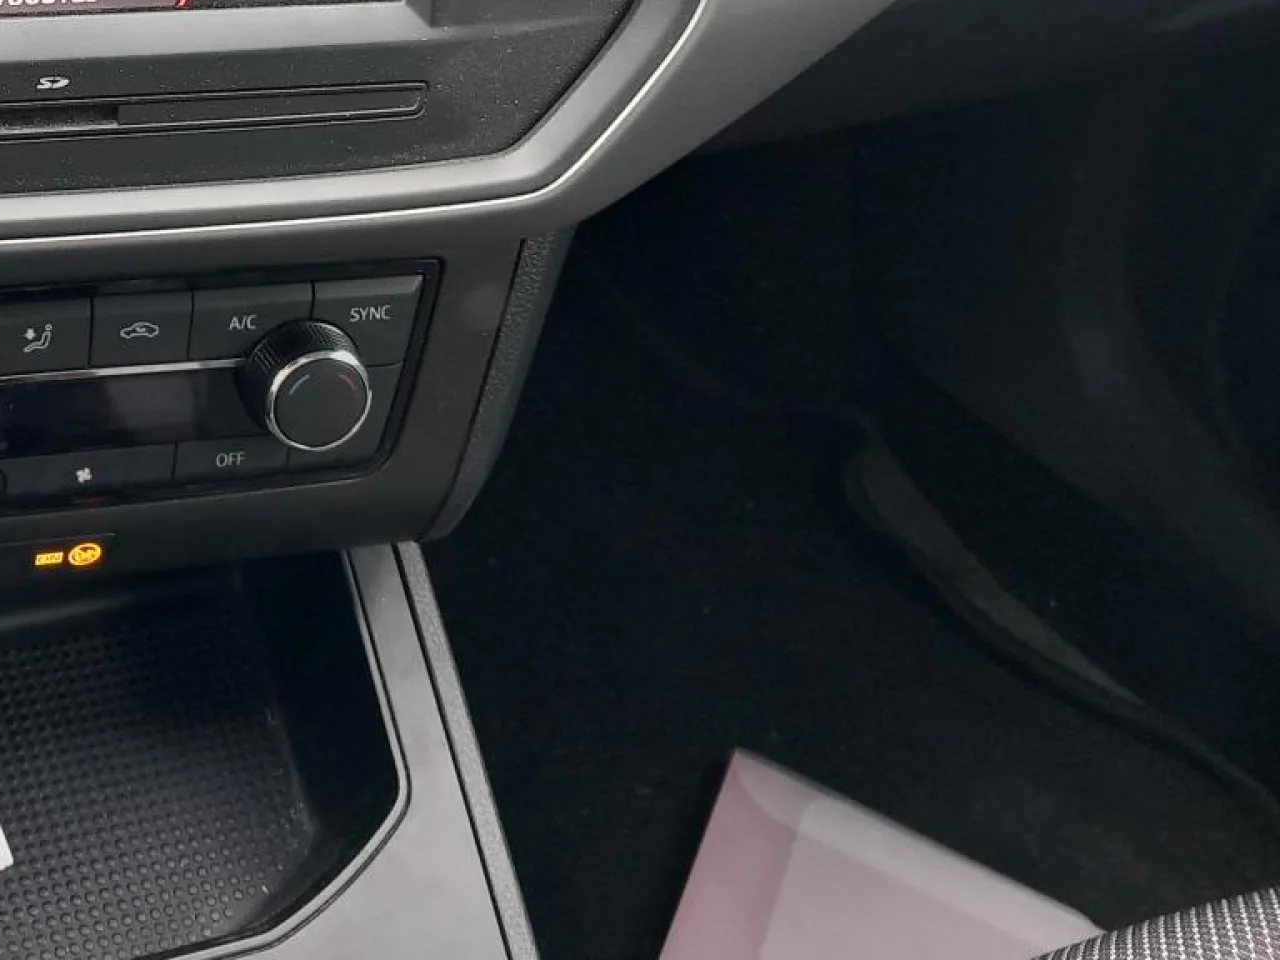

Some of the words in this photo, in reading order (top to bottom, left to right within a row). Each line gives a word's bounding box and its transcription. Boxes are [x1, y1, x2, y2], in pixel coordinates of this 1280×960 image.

[229, 314, 256, 331] A/C
[349, 304, 391, 323] SYNC
[214, 450, 247, 469] OFF
